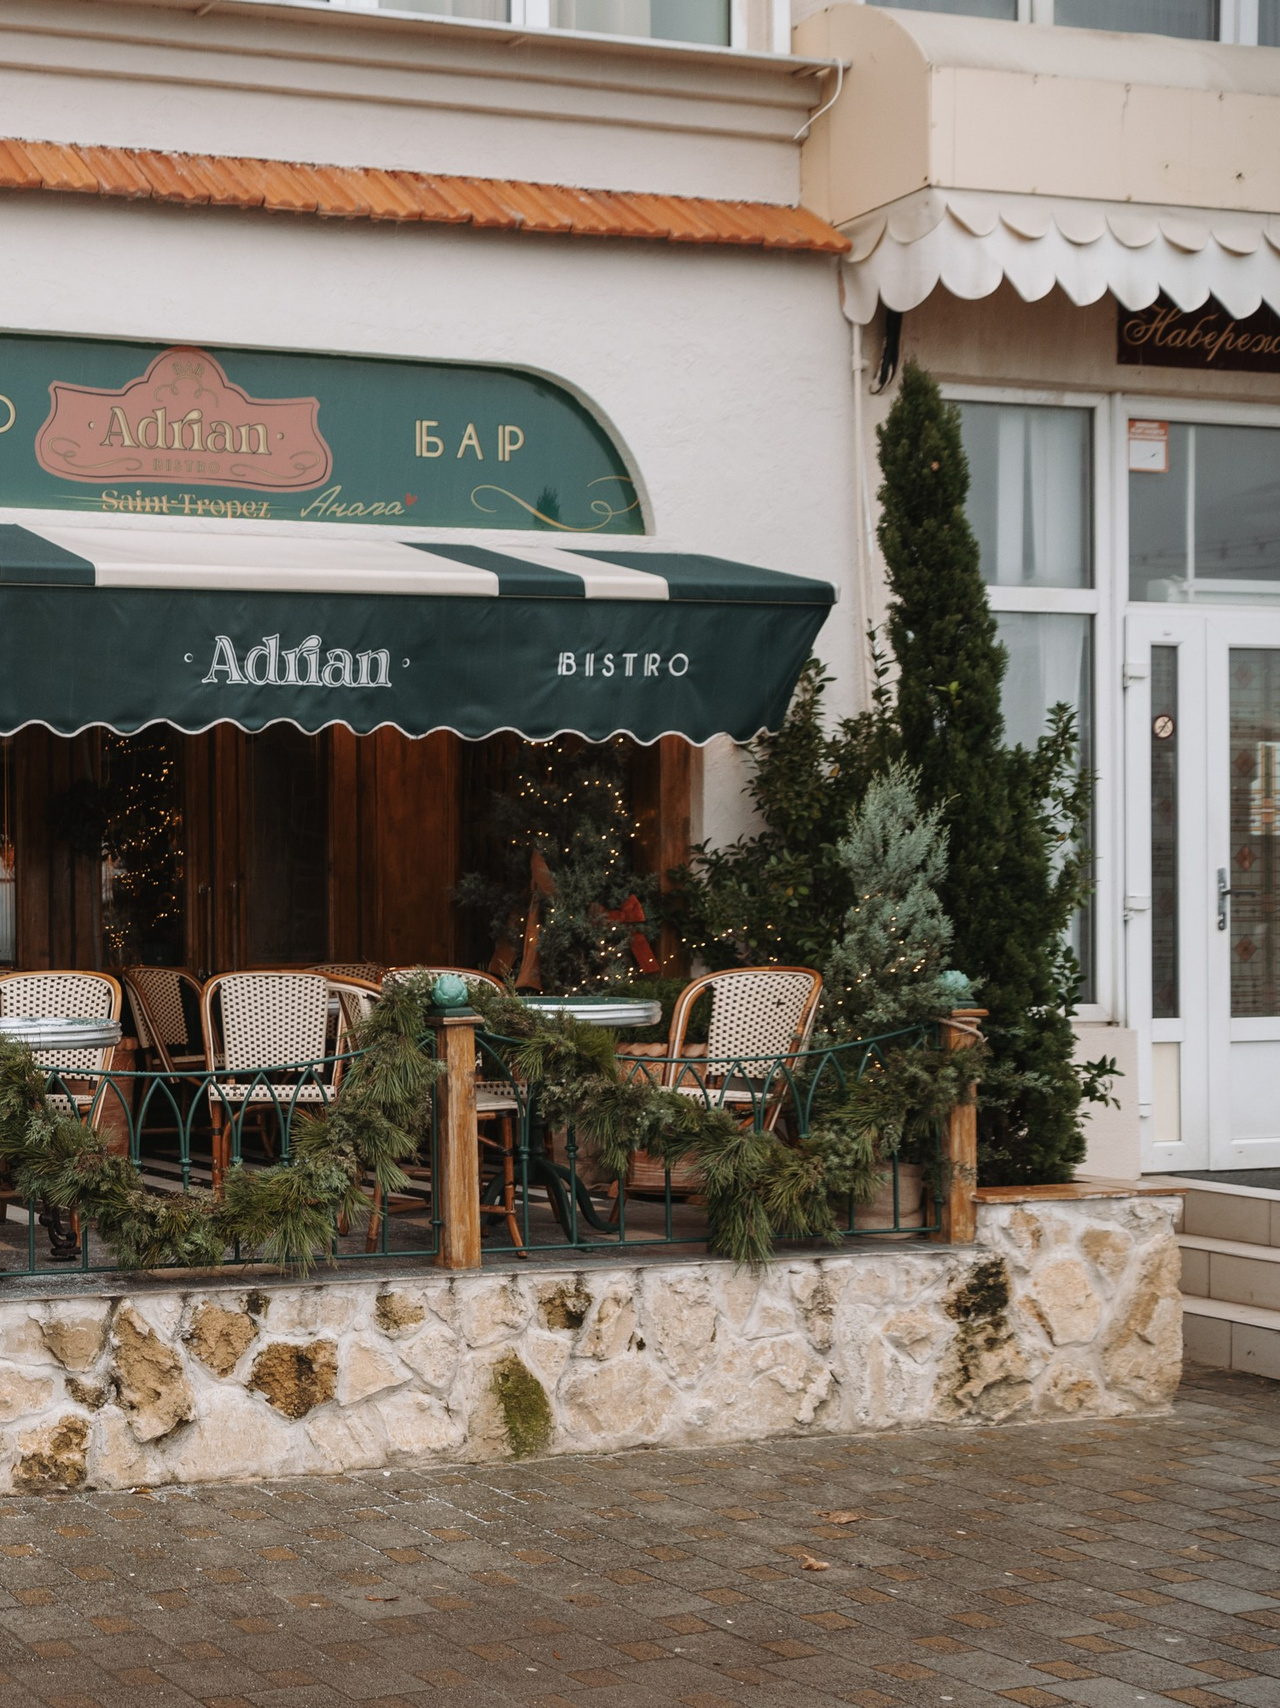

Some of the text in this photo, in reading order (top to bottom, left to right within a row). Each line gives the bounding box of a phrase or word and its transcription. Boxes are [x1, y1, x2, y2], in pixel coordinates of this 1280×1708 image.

[173, 361, 206, 377] BAR
[99, 406, 272, 455] Adrian
[414, 419, 526, 462] БАР
[152, 457, 220, 473] BISTRO
[101, 489, 271, 519] Saint-Tropez
[202, 634, 392, 688] Adrian
[556, 652, 690, 677] BISTRO
